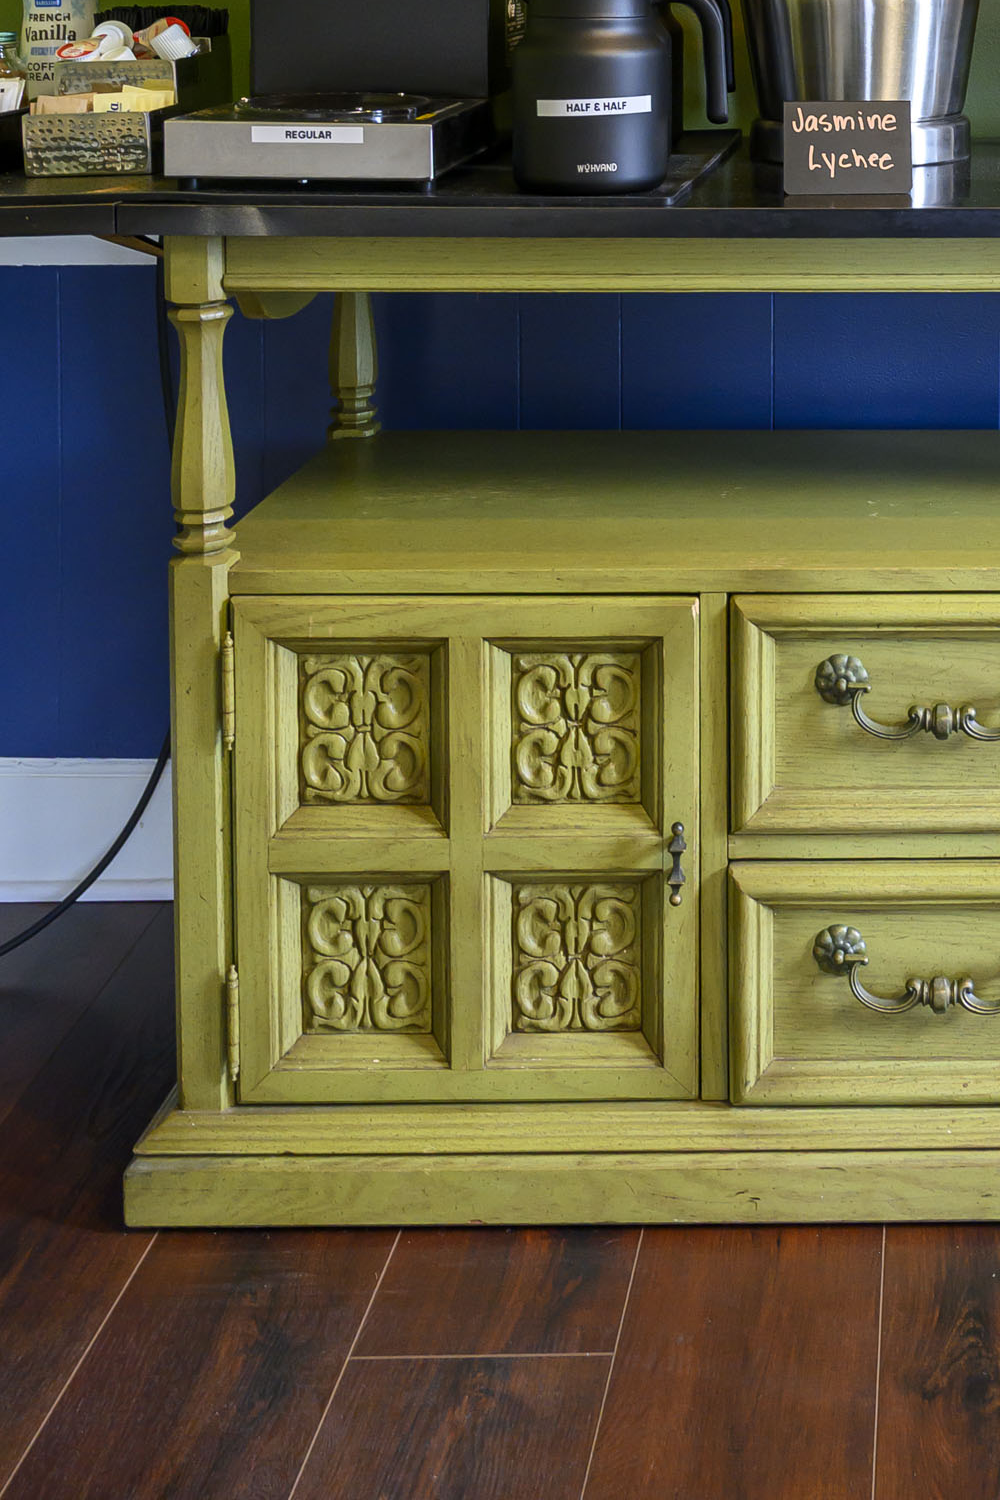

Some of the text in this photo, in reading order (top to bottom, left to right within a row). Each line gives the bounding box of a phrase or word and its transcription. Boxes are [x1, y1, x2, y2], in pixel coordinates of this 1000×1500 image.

[28, 12, 71, 22] FRENCH
[25, 24, 77, 43] Vanilla
[27, 62, 55, 72] COFF
[566, 101, 627, 113] HALF & HALF
[791, 106, 898, 133] Jasmine
[285, 130, 332, 140] REGULAR
[808, 144, 895, 179] Lychee
